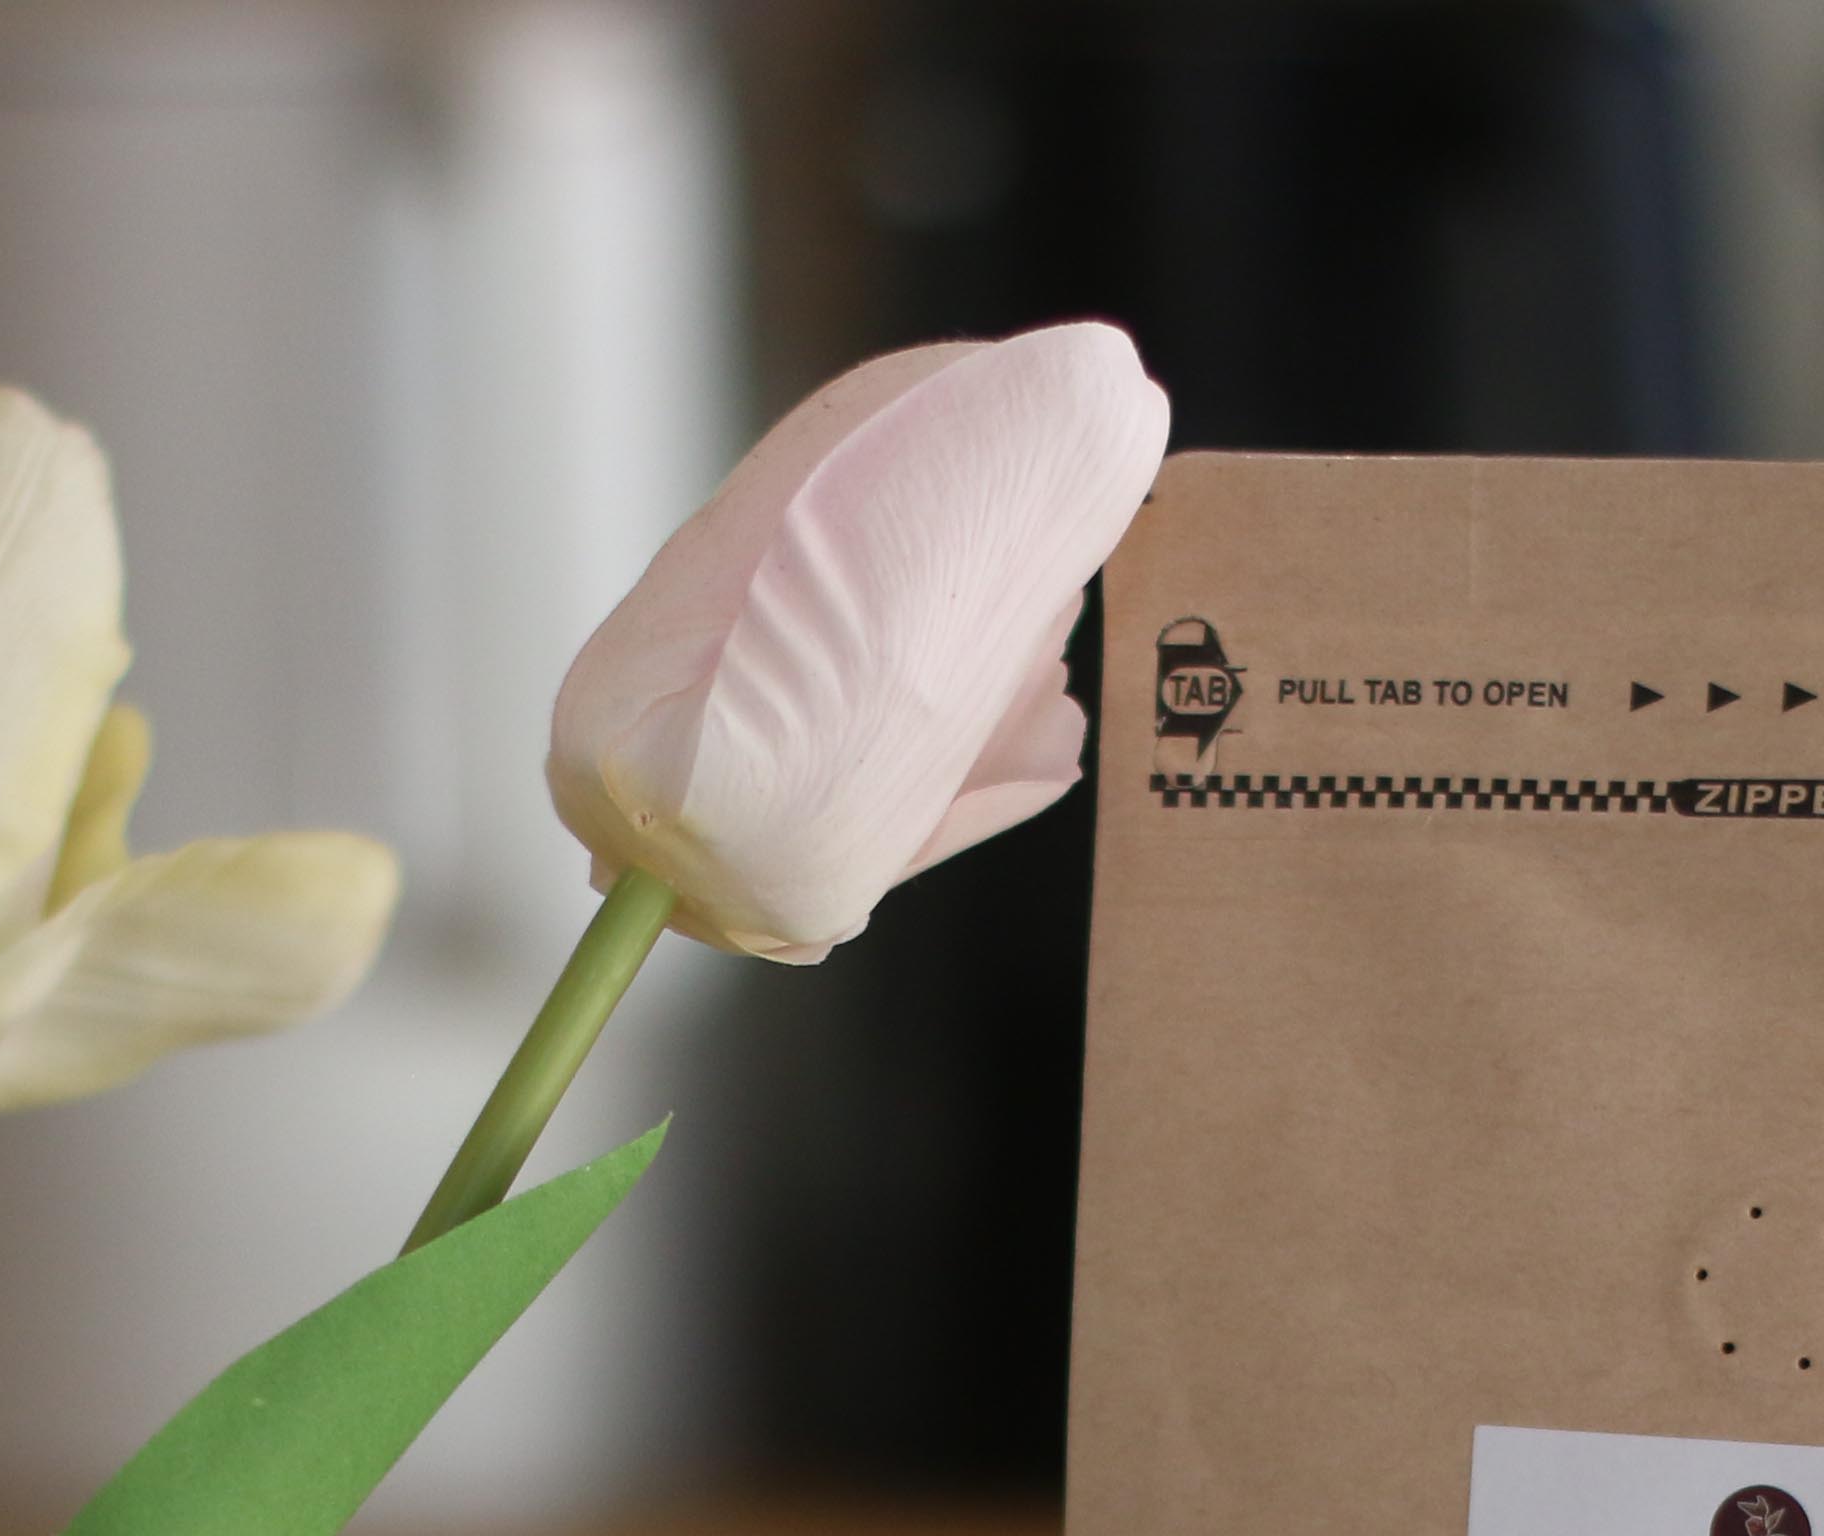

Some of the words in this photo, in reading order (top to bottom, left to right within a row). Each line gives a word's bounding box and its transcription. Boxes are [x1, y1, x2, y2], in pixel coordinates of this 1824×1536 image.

[1169, 675, 1228, 708] TAB
[1278, 679, 1355, 704] PULL
[1364, 679, 1422, 706] TAB
[1433, 680, 1473, 706] TO
[1483, 680, 1569, 708] OPEN
